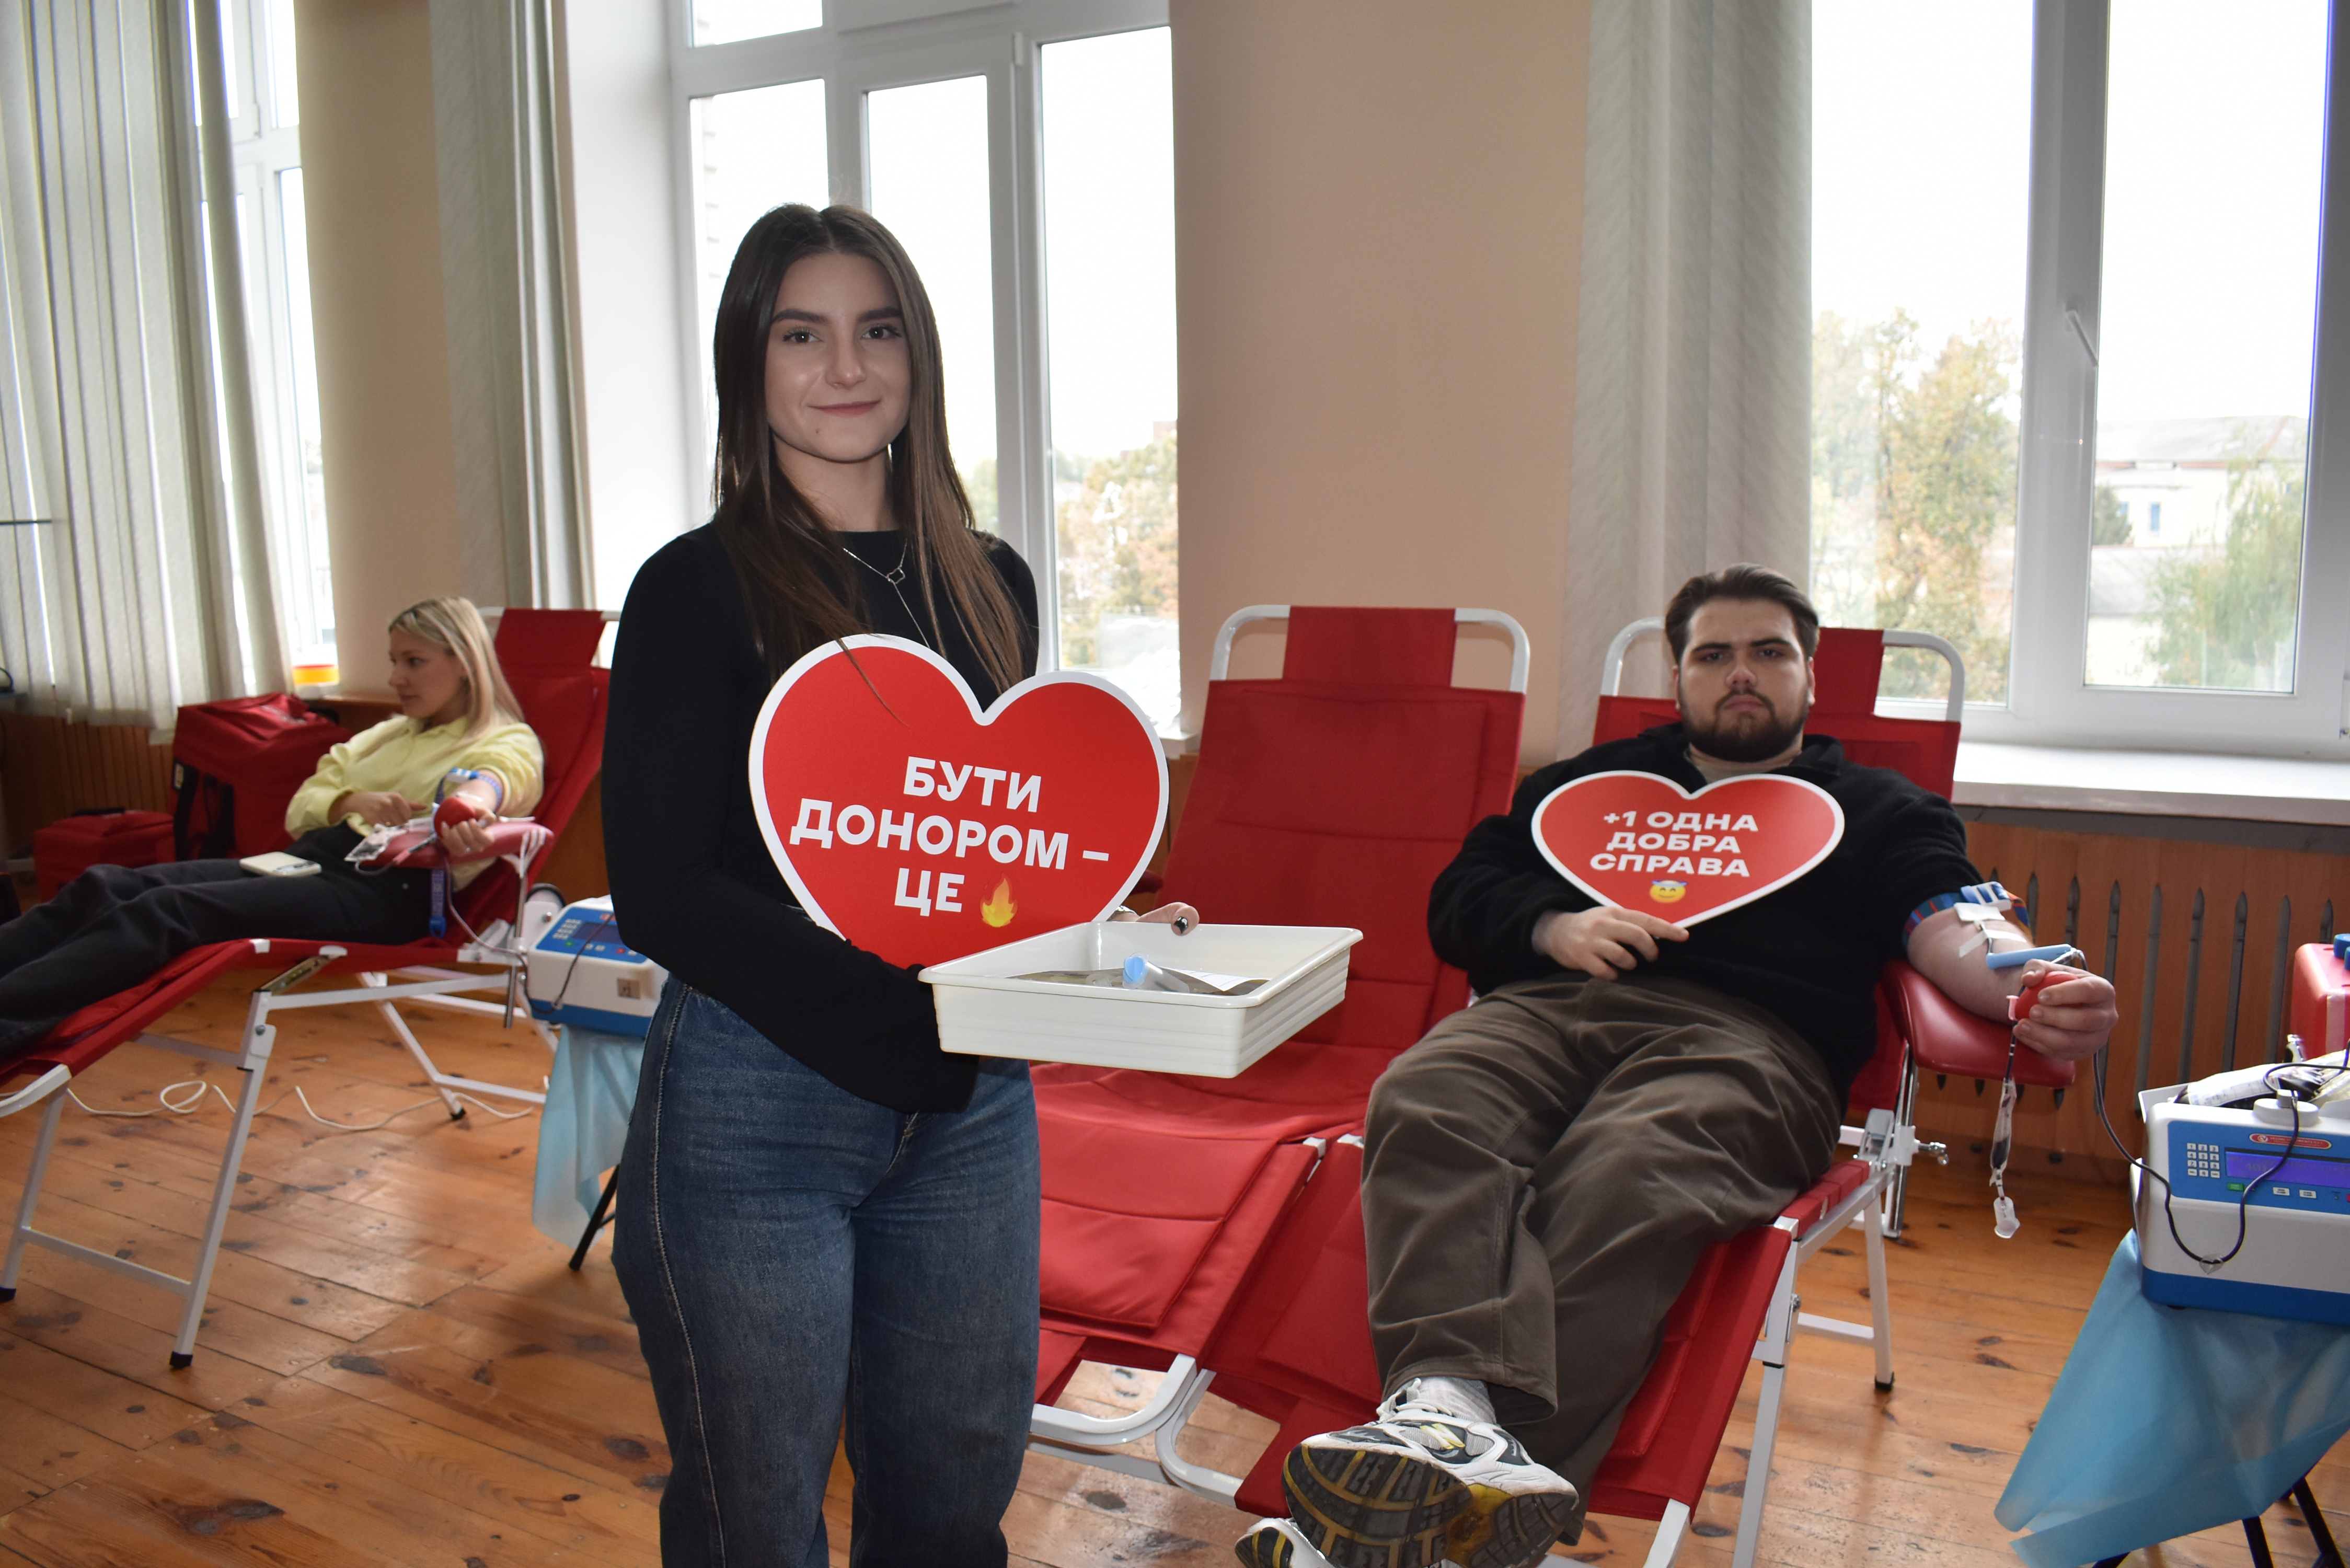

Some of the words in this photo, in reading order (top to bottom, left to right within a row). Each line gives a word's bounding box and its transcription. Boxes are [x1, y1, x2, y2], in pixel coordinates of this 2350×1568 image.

[903, 756, 1042, 813] БУТИ
[789, 798, 1069, 870] ДОНОРОМ
[1604, 811, 1637, 827] +1
[1647, 811, 1759, 832] ОДНА
[1606, 832, 1741, 854] ДОБРА
[1589, 853, 1750, 878] СПРАВА
[894, 868, 965, 917] ЦЕ
